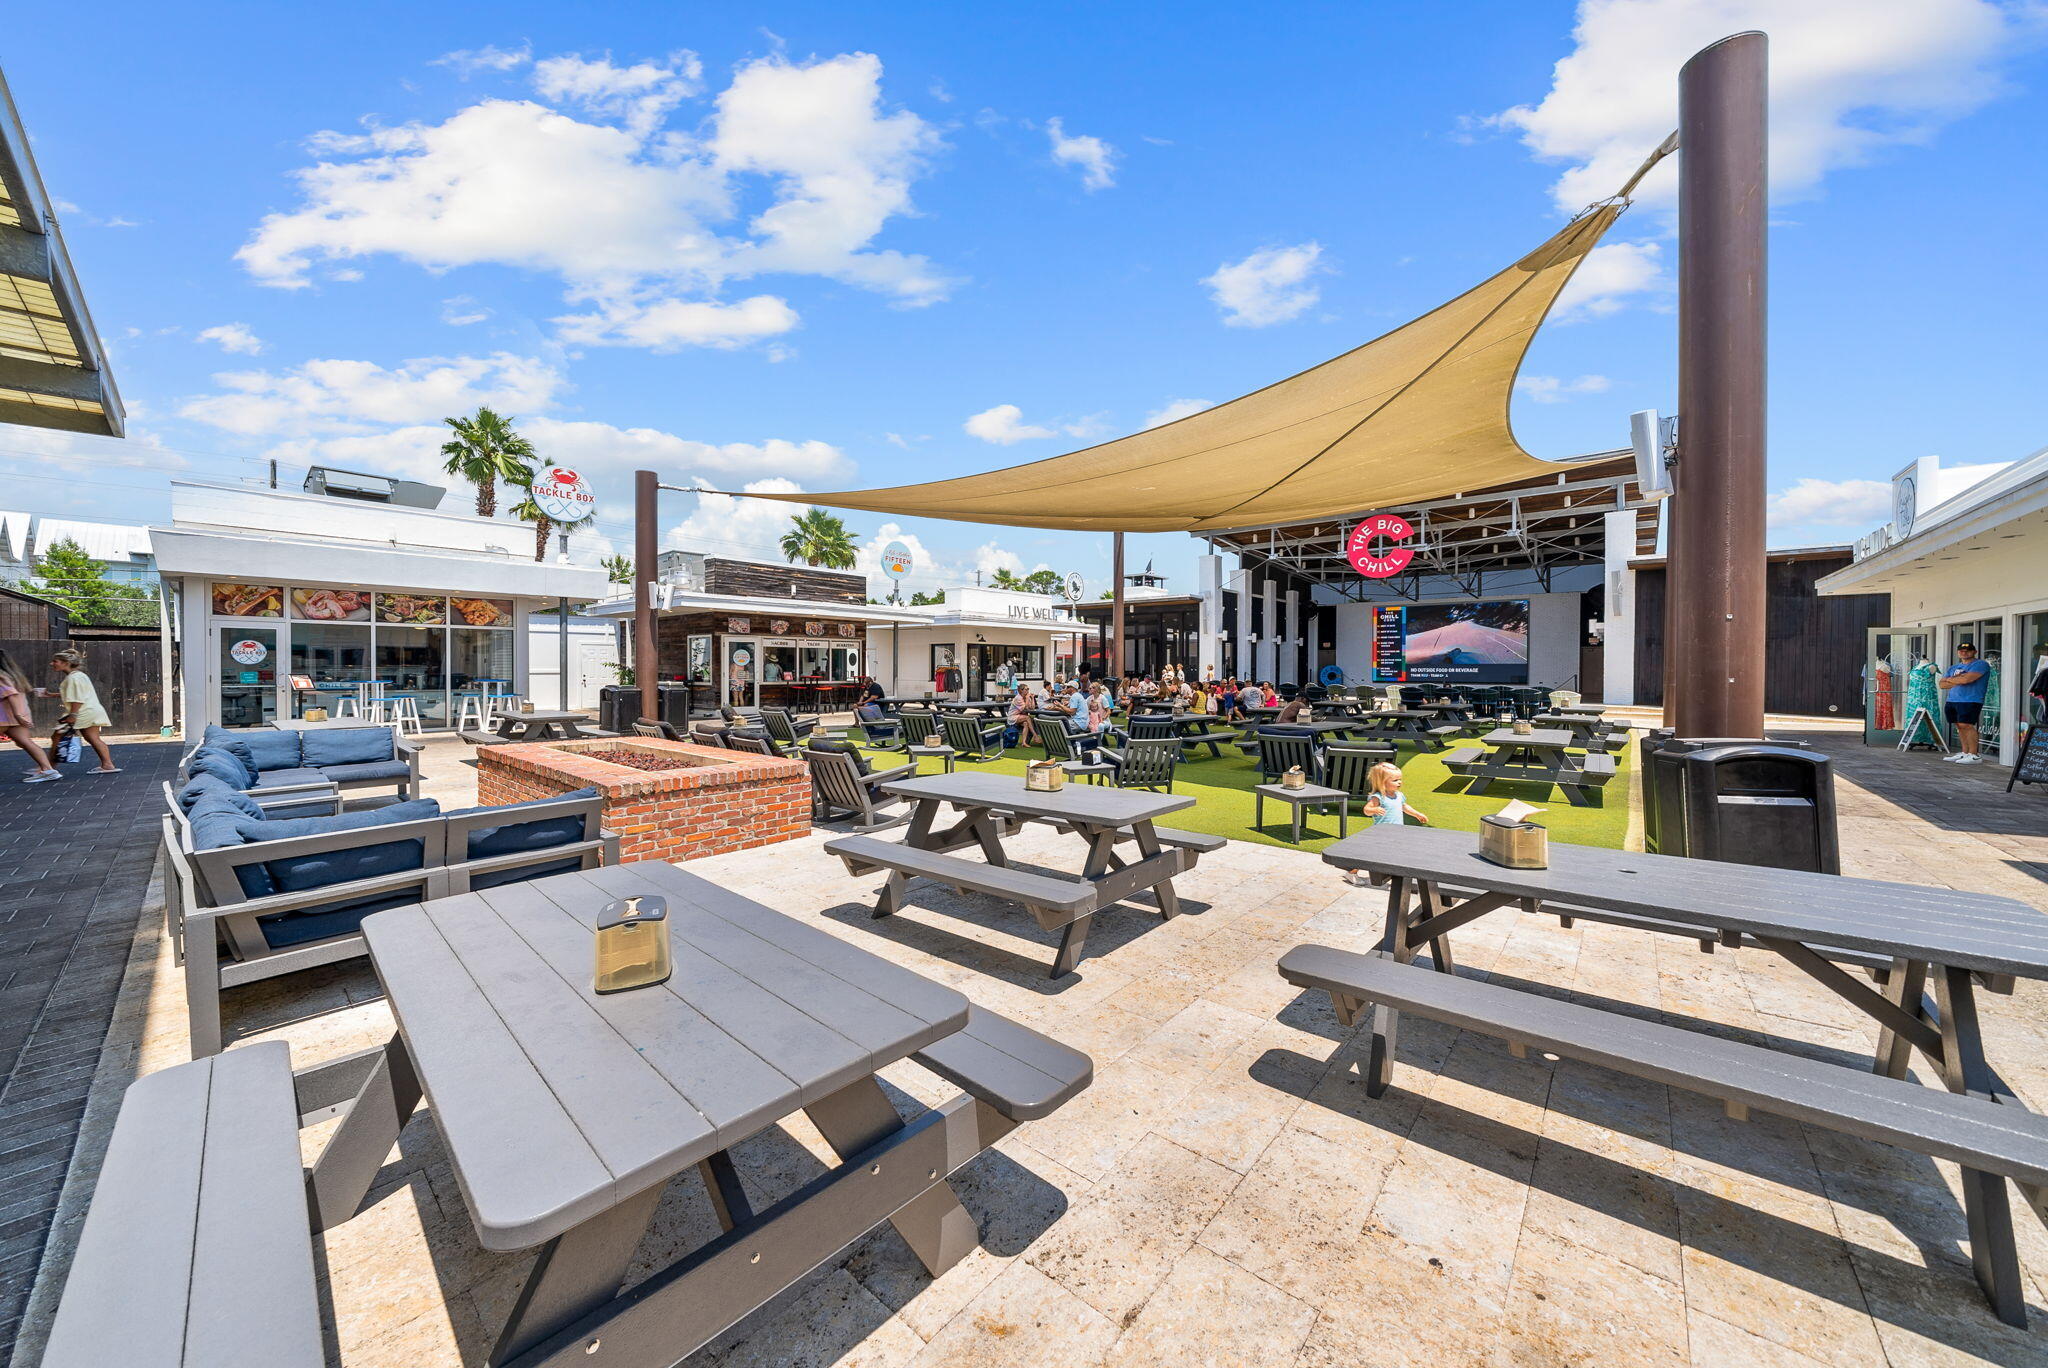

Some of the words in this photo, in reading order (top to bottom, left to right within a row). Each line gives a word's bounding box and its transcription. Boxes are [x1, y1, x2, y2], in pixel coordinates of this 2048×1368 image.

[533, 485, 572, 500] TACKLE
[576, 493, 595, 503] BOX
[1352, 525, 1373, 552] THE
[1377, 519, 1403, 535] BIG
[885, 555, 911, 565] FIFTEEN
[1357, 556, 1403, 573] CHILL
[1008, 604, 1029, 619] LIVE
[1032, 606, 1058, 621] WELL
